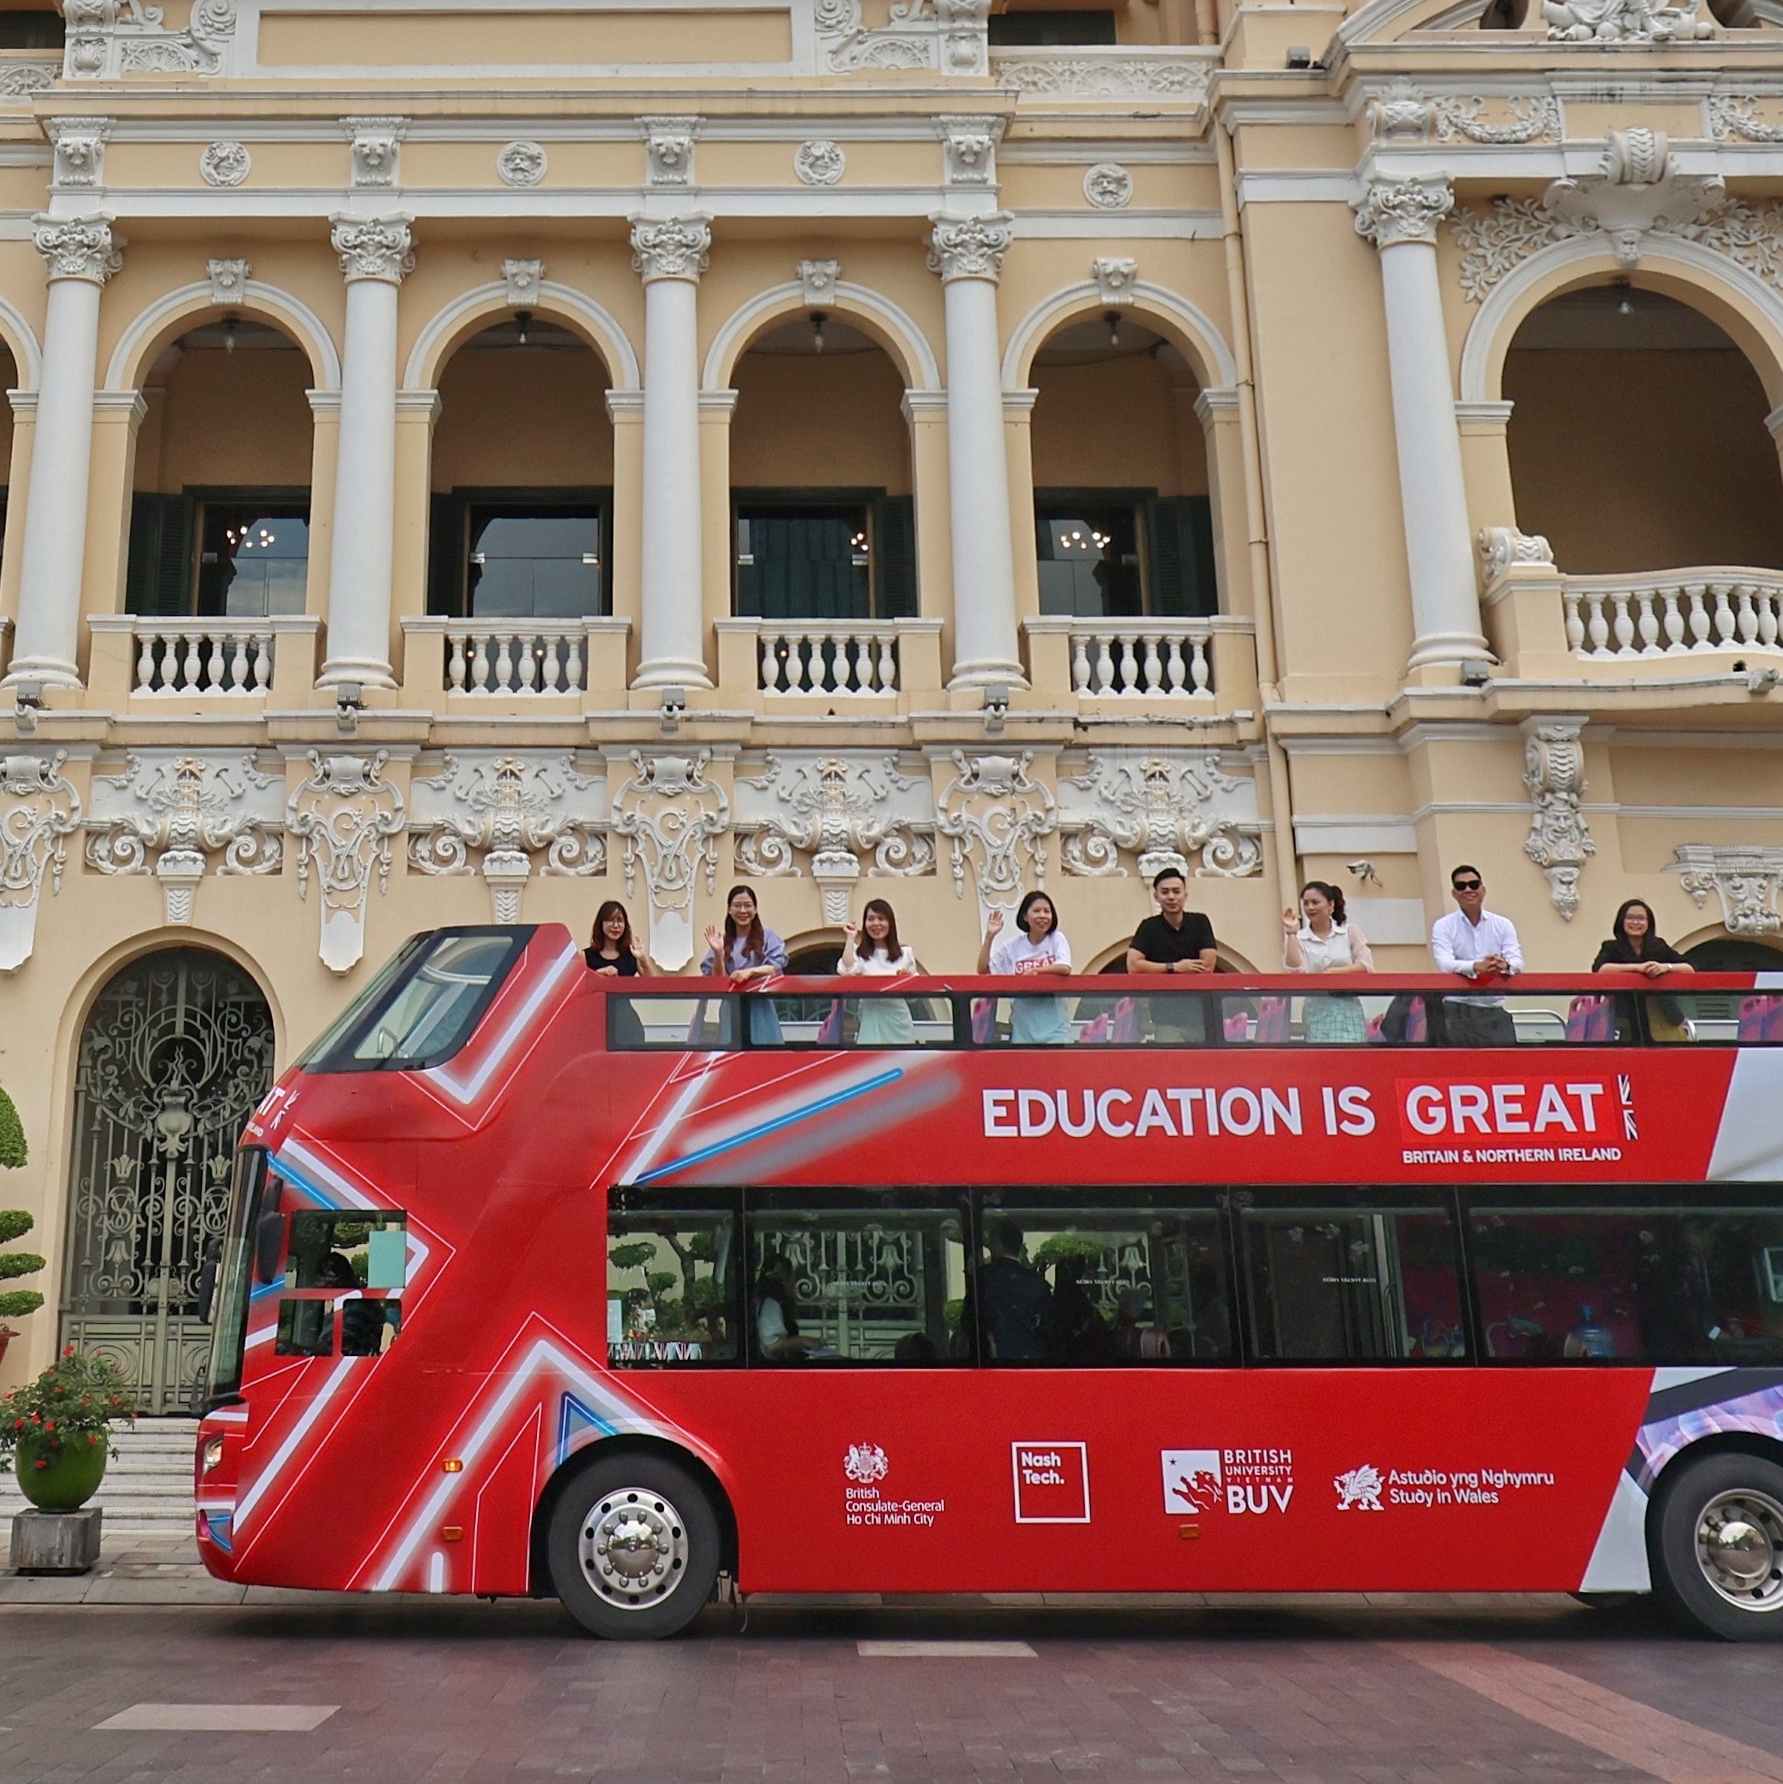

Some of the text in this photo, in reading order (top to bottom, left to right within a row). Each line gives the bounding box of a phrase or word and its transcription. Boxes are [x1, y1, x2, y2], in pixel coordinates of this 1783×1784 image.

[982, 1083, 1604, 1138] EDUCATION IS GREAT
[1402, 1147, 1622, 1164] BRITAIN & NORTHERN IRELAND
[1021, 1452, 1061, 1467] Nash
[1223, 1449, 1292, 1464] BRITISH
[1022, 1469, 1065, 1485] Tech.
[1225, 1465, 1292, 1476] UNIVERSITY
[1449, 1472, 1479, 1488] yng
[1481, 1469, 1555, 1488] Nghymru
[846, 1487, 879, 1499] British
[1226, 1485, 1294, 1514] BUV
[1436, 1488, 1452, 1504] in
[1453, 1488, 1499, 1504] Wales
[846, 1500, 945, 1513] Consulate-General
[847, 1513, 935, 1527] Ho Chi Minh City
